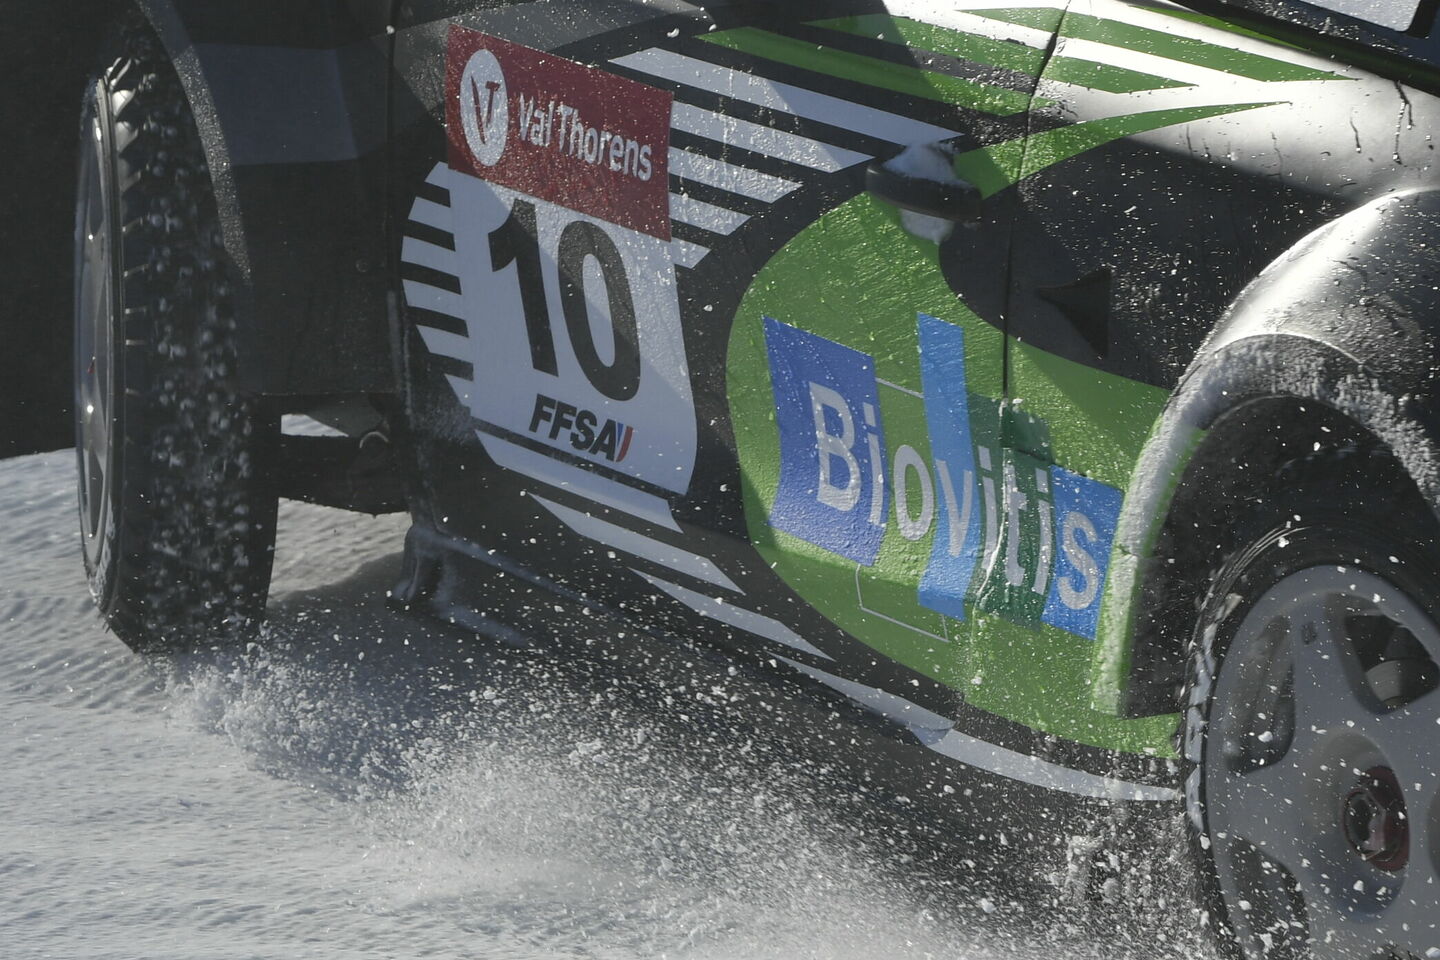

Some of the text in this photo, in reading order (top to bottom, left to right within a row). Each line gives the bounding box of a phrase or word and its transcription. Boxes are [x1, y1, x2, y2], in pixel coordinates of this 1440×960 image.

[519, 92, 652, 181] Val Thorens
[487, 198, 641, 401] 10
[528, 393, 620, 462] FFSA
[808, 380, 1099, 611] Biovitis
